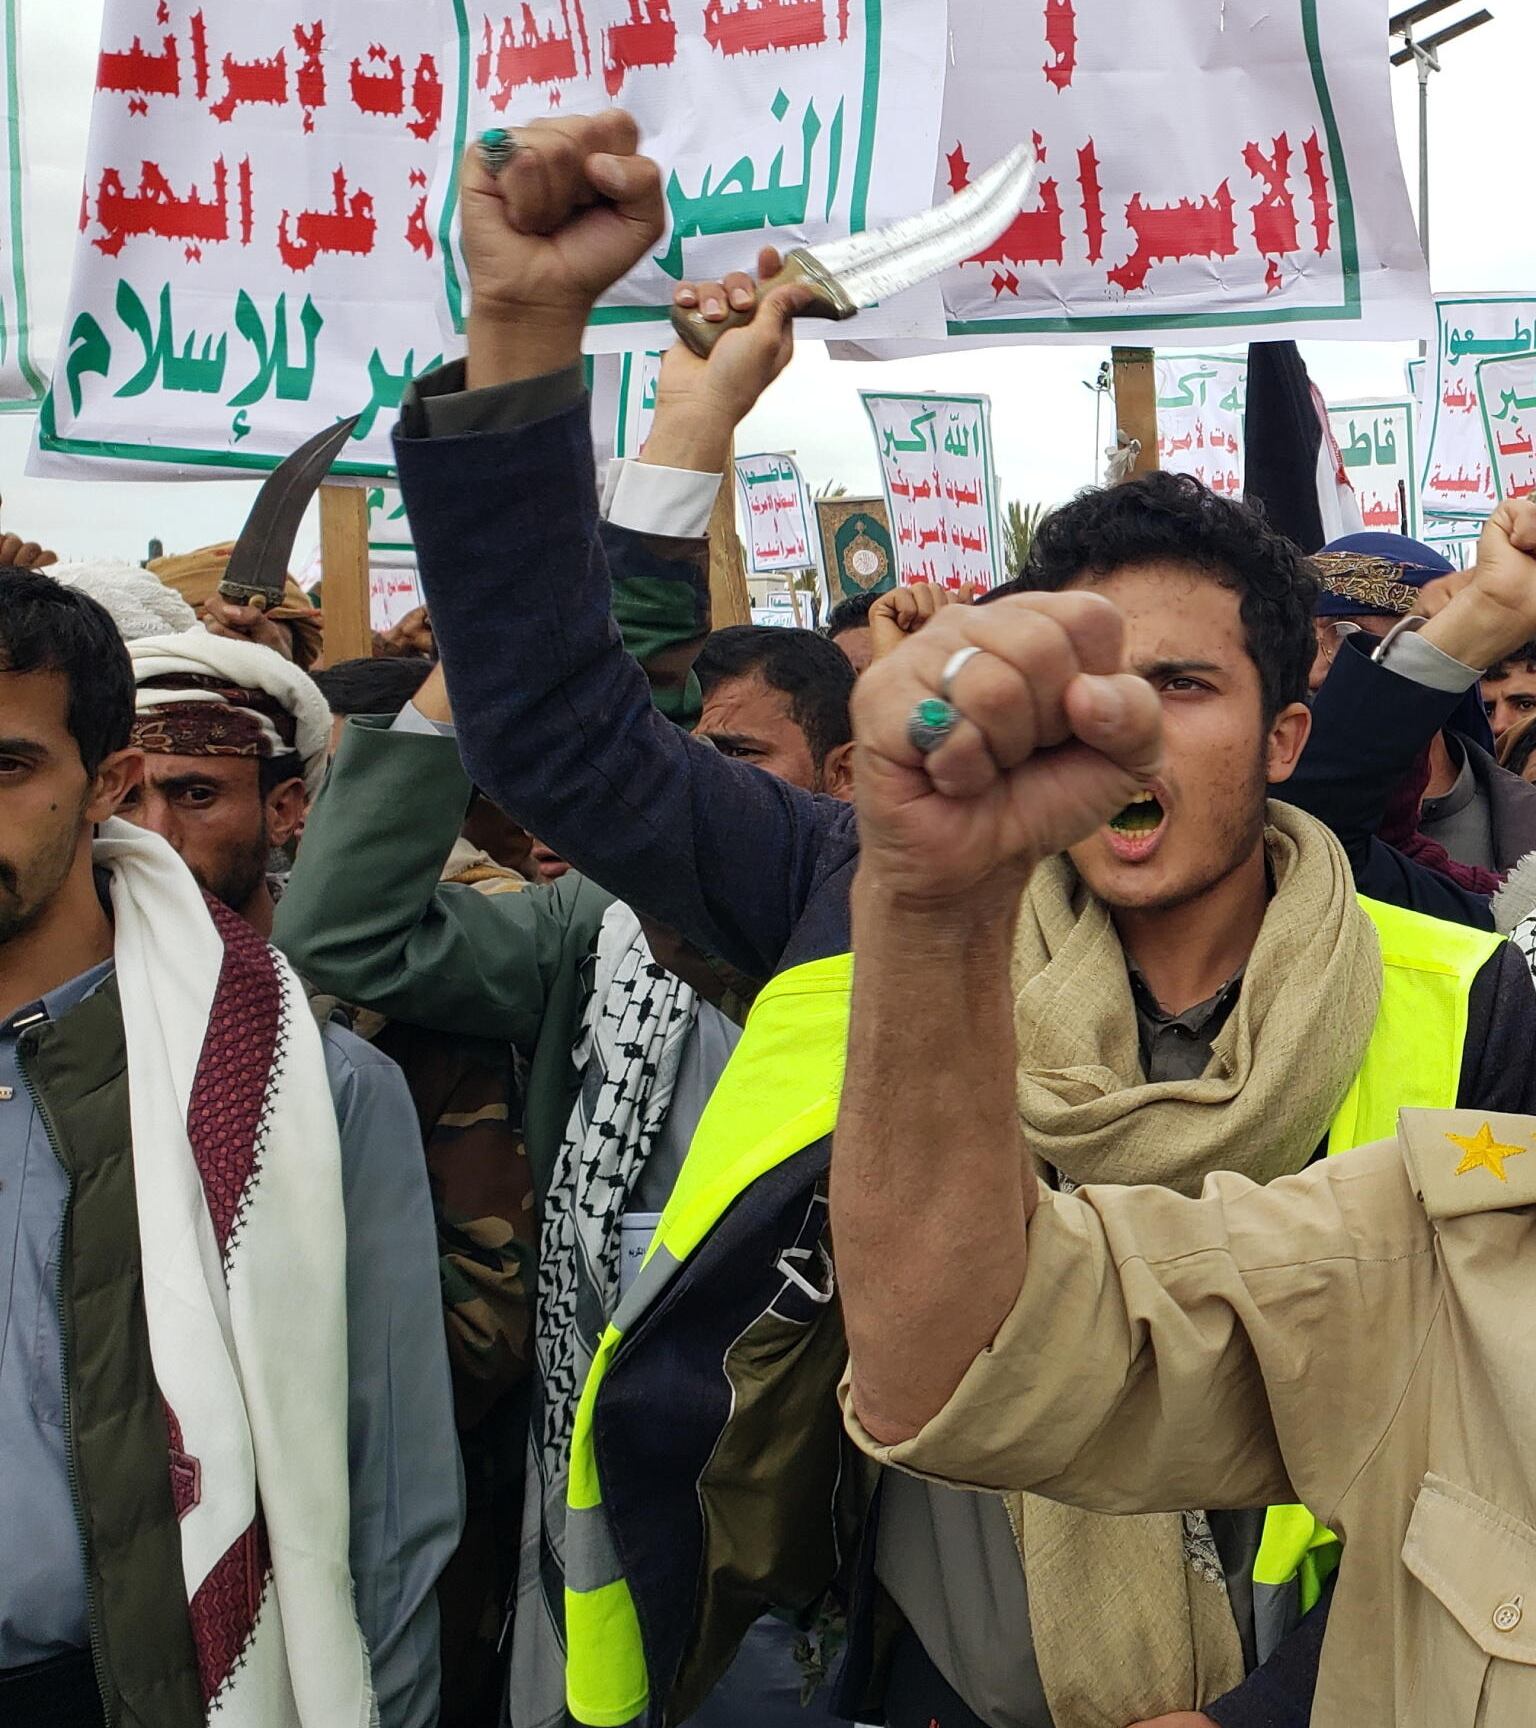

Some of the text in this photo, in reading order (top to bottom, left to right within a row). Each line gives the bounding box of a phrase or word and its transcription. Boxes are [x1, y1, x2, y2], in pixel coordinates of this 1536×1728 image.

[80, 152, 255, 264] اليهو
[278, 162, 377, 273] على
[652, 87, 845, 281] النصر
[65, 278, 324, 442] للإسلام
[883, 403, 980, 465] الله أكبر
